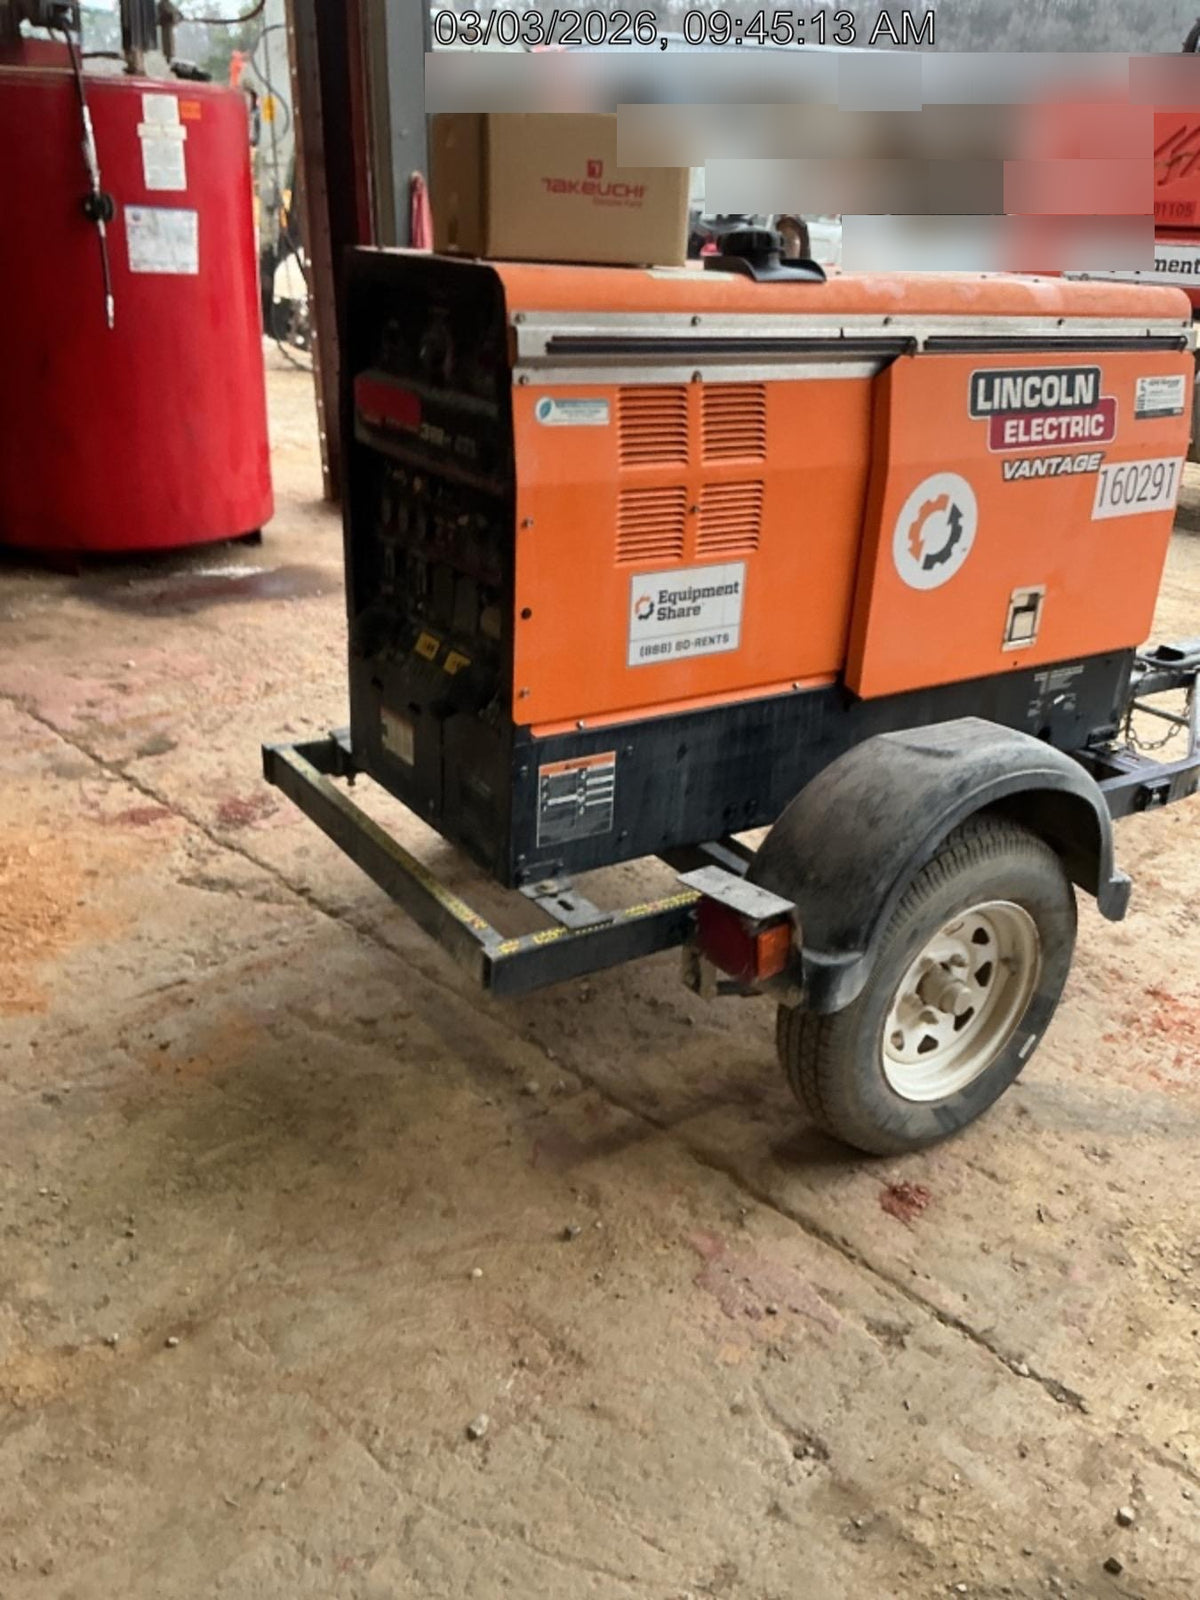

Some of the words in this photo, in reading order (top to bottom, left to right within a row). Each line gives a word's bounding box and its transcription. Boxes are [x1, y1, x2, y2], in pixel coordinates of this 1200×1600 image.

[976, 373, 1095, 411] LINCOLN
[1004, 413, 1105, 444] ELECTRIC
[1003, 453, 1104, 481] VANTAGE
[1099, 461, 1176, 508] 160291
[658, 581, 739, 605] Equipment
[656, 604, 701, 621] Share
